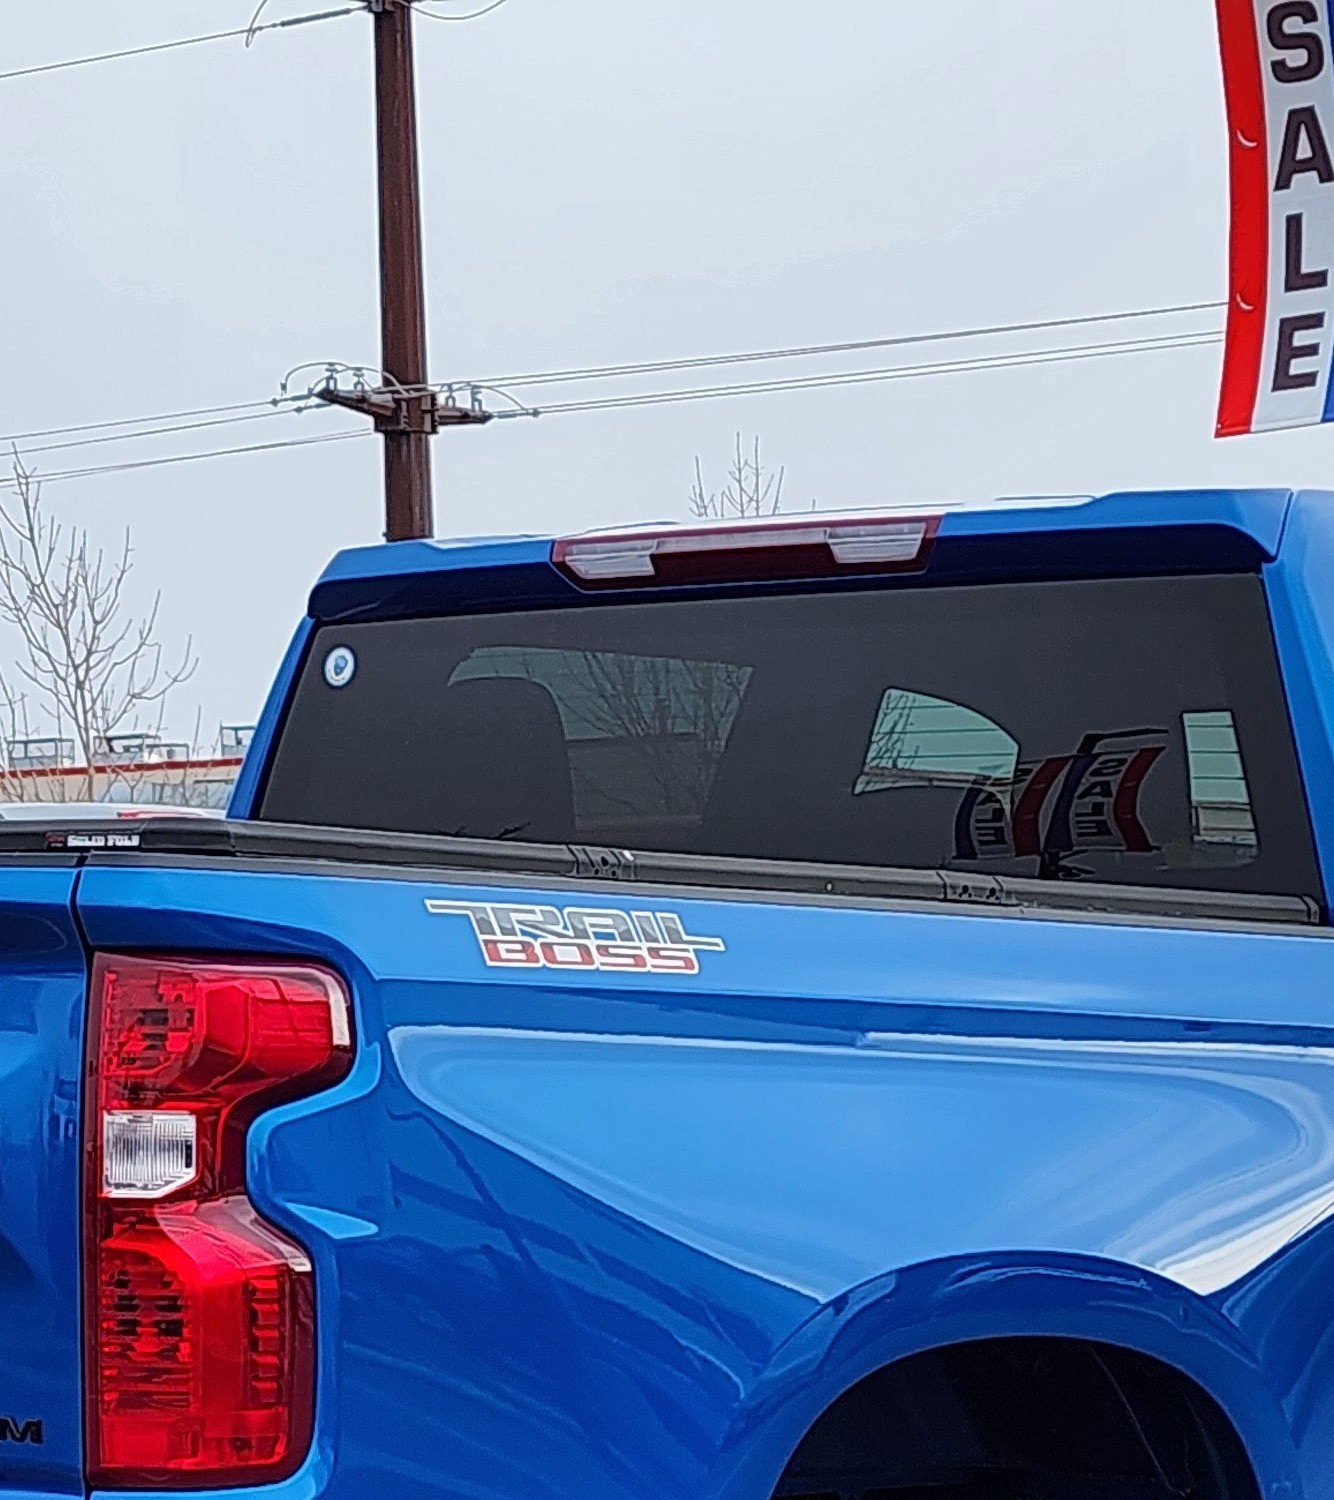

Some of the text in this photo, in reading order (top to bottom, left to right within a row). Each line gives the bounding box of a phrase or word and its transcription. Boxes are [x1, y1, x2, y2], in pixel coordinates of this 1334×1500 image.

[1267, 1, 1334, 393] SALE
[424, 898, 725, 951] TRAIL
[481, 937, 699, 974] BOSS
